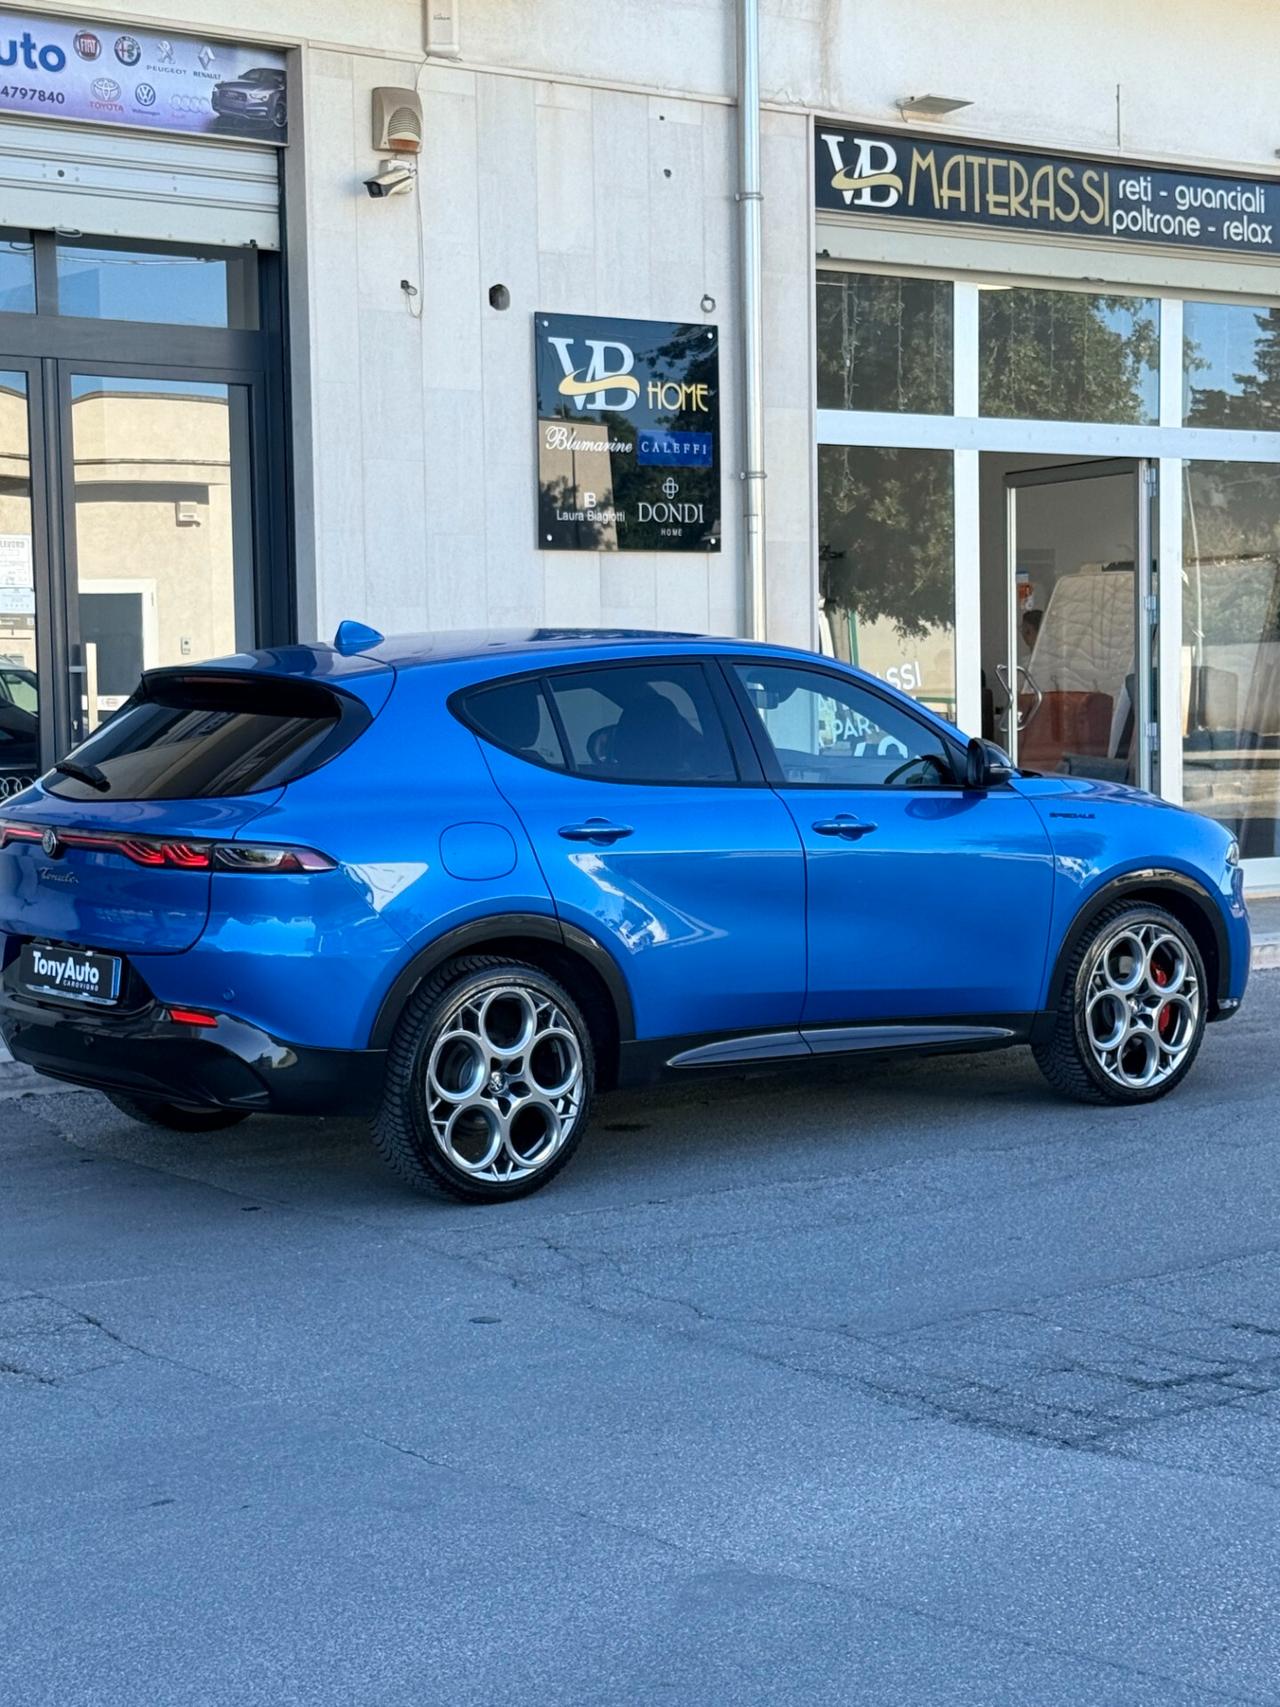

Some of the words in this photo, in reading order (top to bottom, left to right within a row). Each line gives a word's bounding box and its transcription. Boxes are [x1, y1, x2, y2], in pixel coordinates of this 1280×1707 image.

[80, 38, 98, 53] FIAT
[146, 64, 187, 75] PEUGEOT
[193, 71, 221, 79] RENAULT
[0, 85, 65, 104] 4797840
[90, 101, 124, 112] TOYOTA
[908, 147, 1109, 226] MATERASSI
[1119, 176, 1151, 201] reti
[1175, 185, 1265, 213] guanciali
[1113, 205, 1200, 237] poltrone
[1223, 215, 1272, 244] relax
[647, 381, 708, 412] HOME
[545, 425, 632, 453] Blumarine
[641, 441, 707, 455] CALEFFI
[556, 510, 584, 522] Laura
[587, 511, 625, 524] Biagiotti
[638, 502, 704, 524] DONDI
[661, 528, 682, 537] HOME
[876, 661, 921, 690] SSI
[33, 951, 99, 984] TonyAuto
[63, 980, 99, 992] CAROVIGNO
